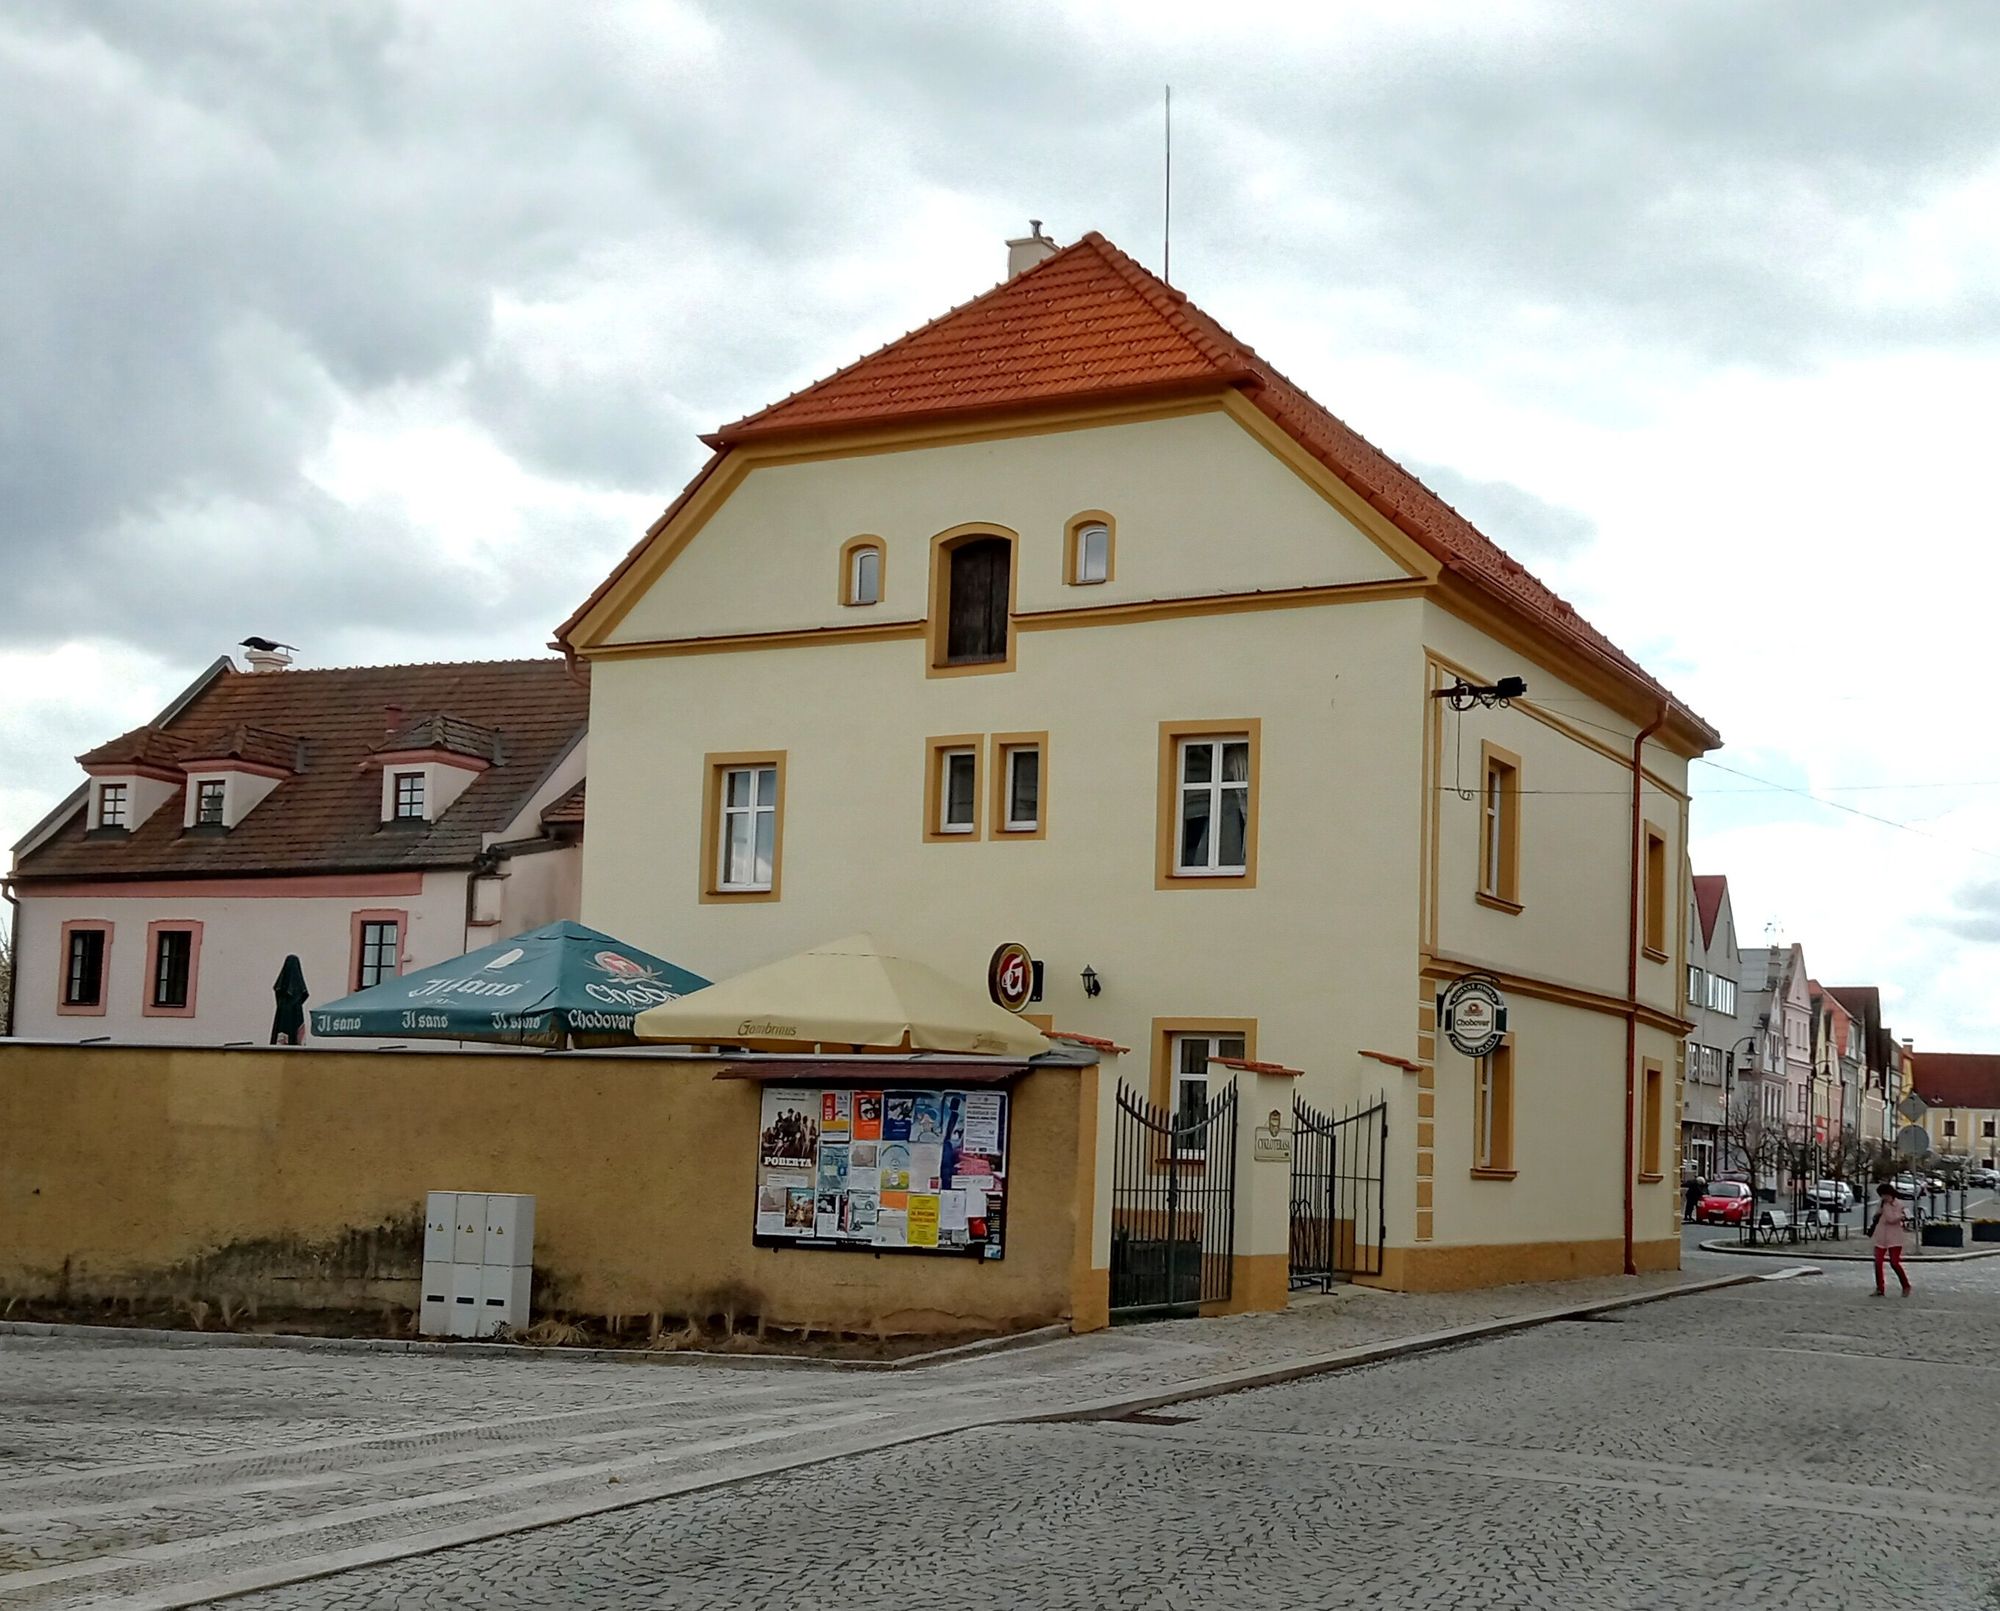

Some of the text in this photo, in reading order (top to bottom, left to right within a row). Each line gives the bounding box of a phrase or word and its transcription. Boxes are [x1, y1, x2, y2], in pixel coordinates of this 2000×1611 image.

[332, 1017, 361, 1031] sano
[418, 1014, 449, 1028] sano
[568, 1010, 634, 1030] Chodovar
[737, 1020, 797, 1036] Gambrinus
